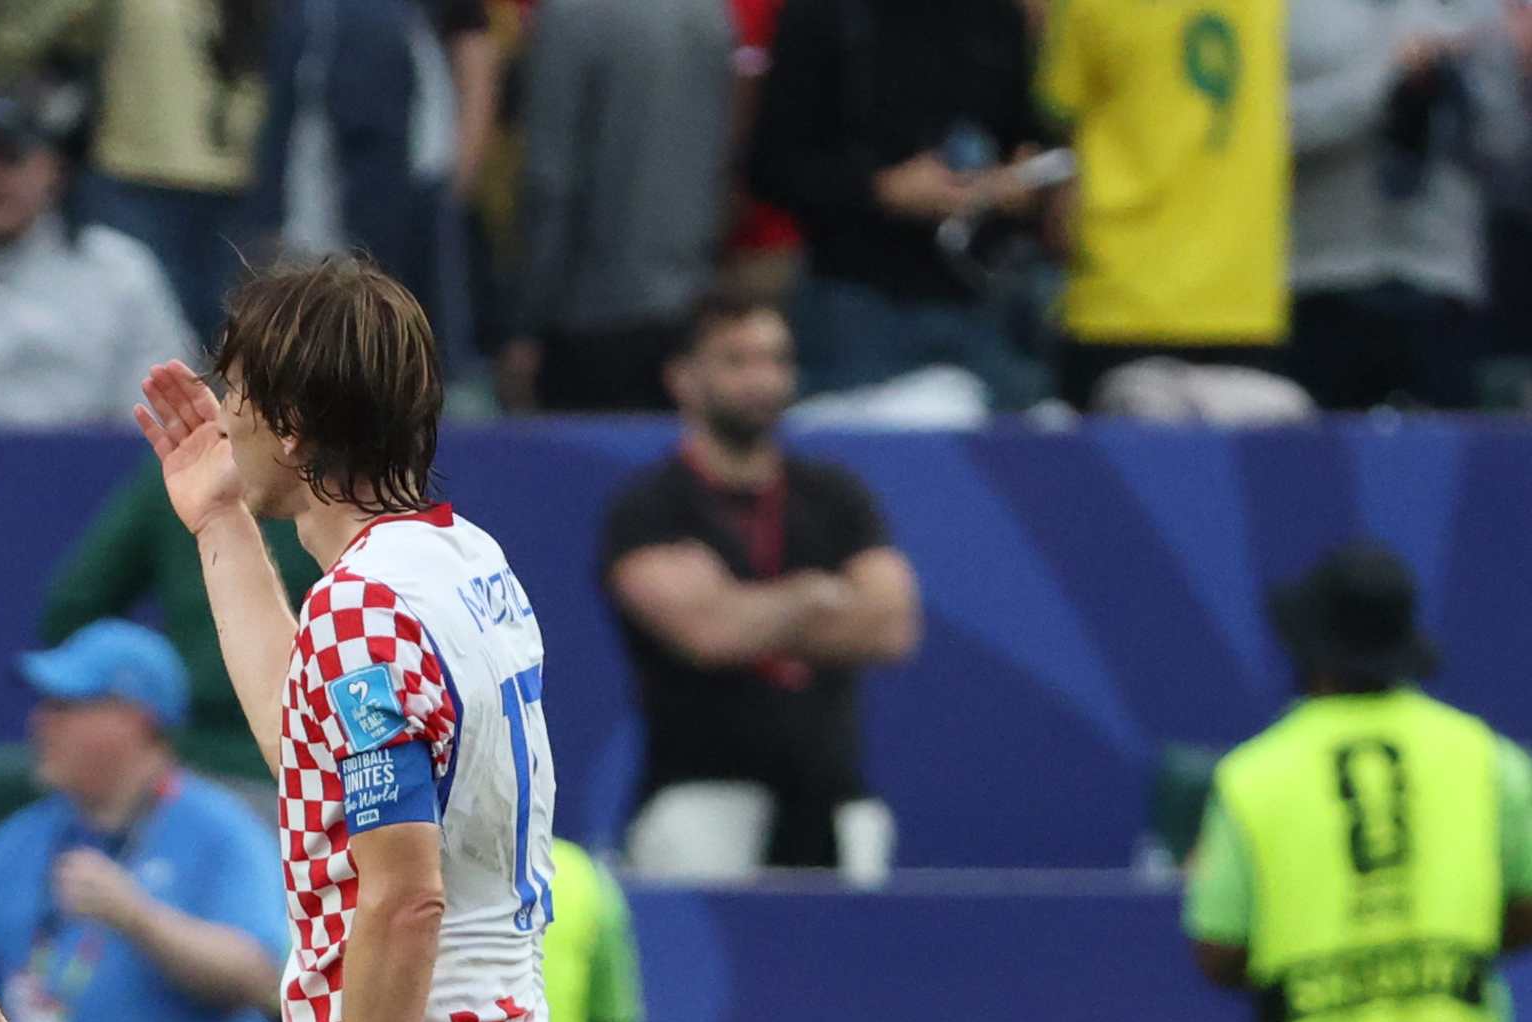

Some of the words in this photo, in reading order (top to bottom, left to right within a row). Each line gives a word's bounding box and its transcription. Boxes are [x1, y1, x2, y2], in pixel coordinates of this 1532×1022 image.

[342, 748, 394, 775] FOOTBALL
[344, 763, 396, 795] UNITES
[358, 783, 400, 810] World
